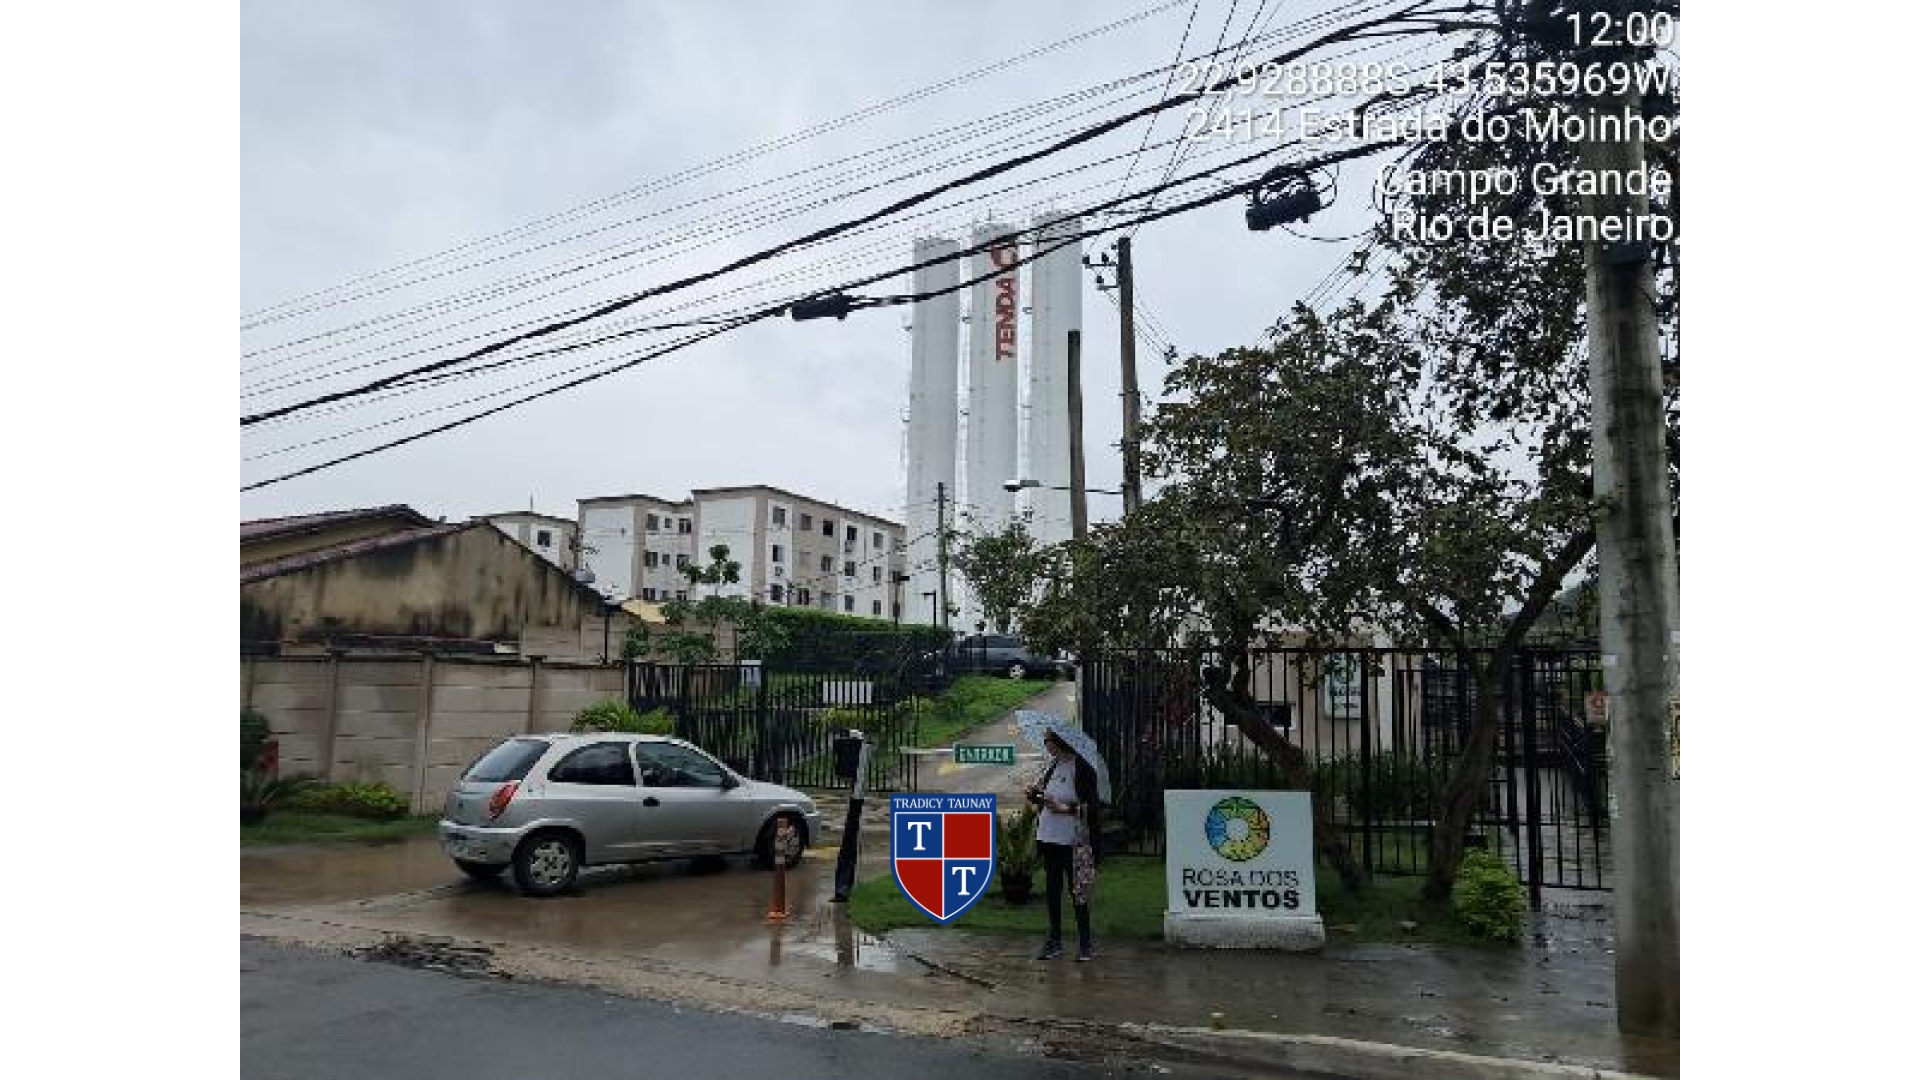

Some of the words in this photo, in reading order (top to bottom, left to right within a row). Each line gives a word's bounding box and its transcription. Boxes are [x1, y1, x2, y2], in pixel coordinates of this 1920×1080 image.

[995, 277, 1018, 362] TENDA
[1183, 868, 1244, 886] ROSA
[1249, 870, 1300, 886] DOS
[1183, 889, 1301, 910] VENTOS
